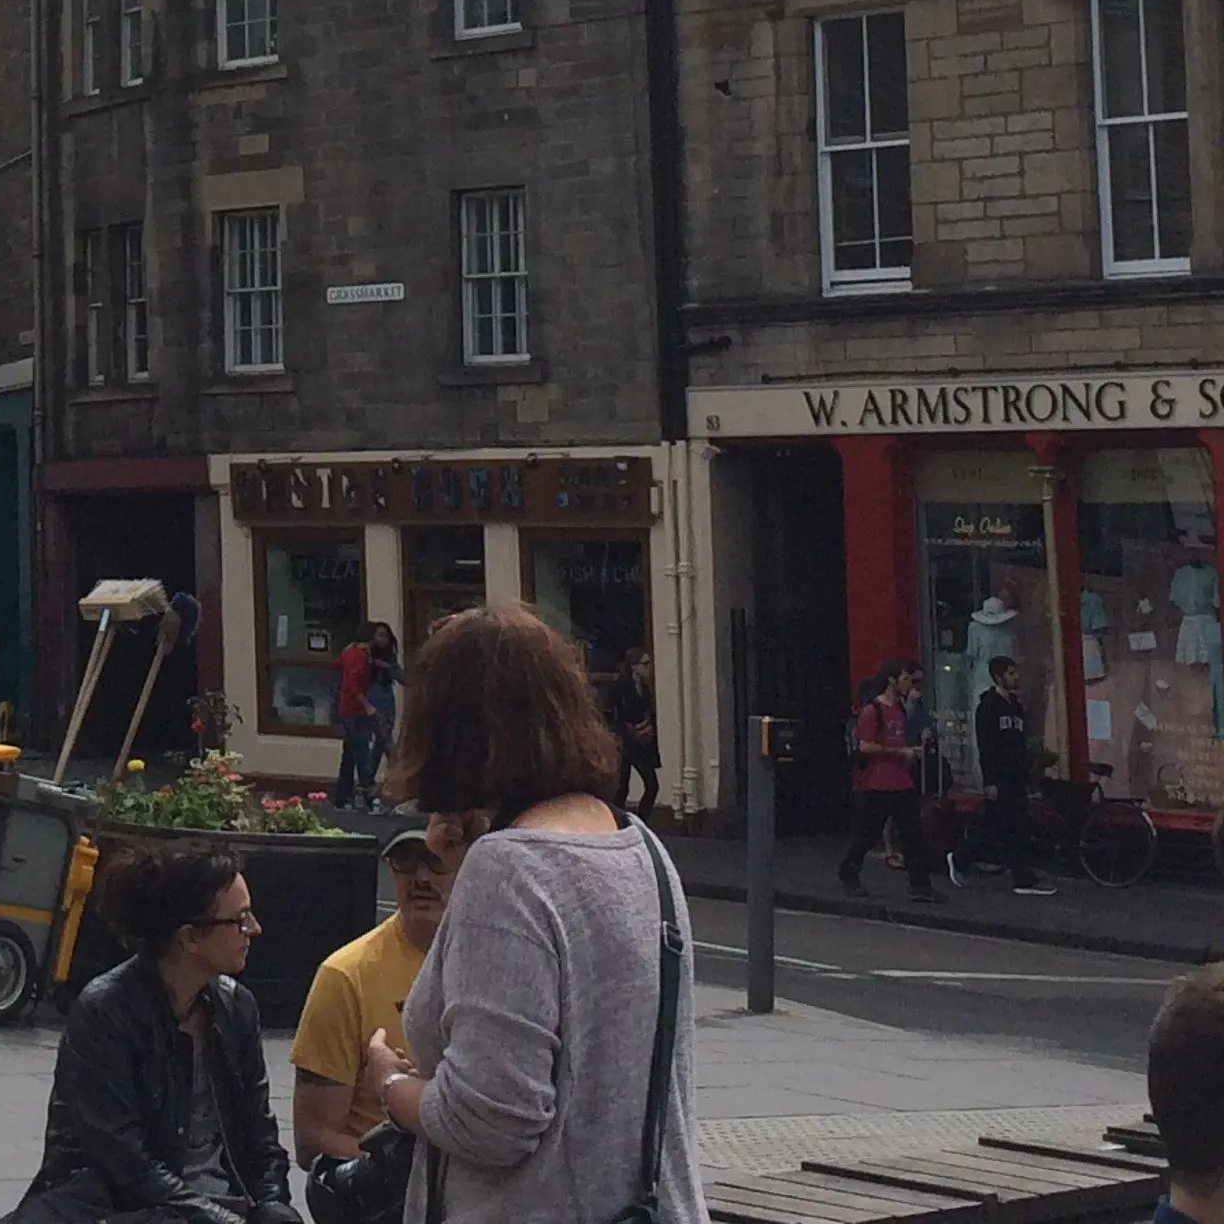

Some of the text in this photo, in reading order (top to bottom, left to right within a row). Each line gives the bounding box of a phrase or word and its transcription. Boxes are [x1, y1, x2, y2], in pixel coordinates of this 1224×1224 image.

[803, 378, 1224, 428] W. ARMSTRONG & S
